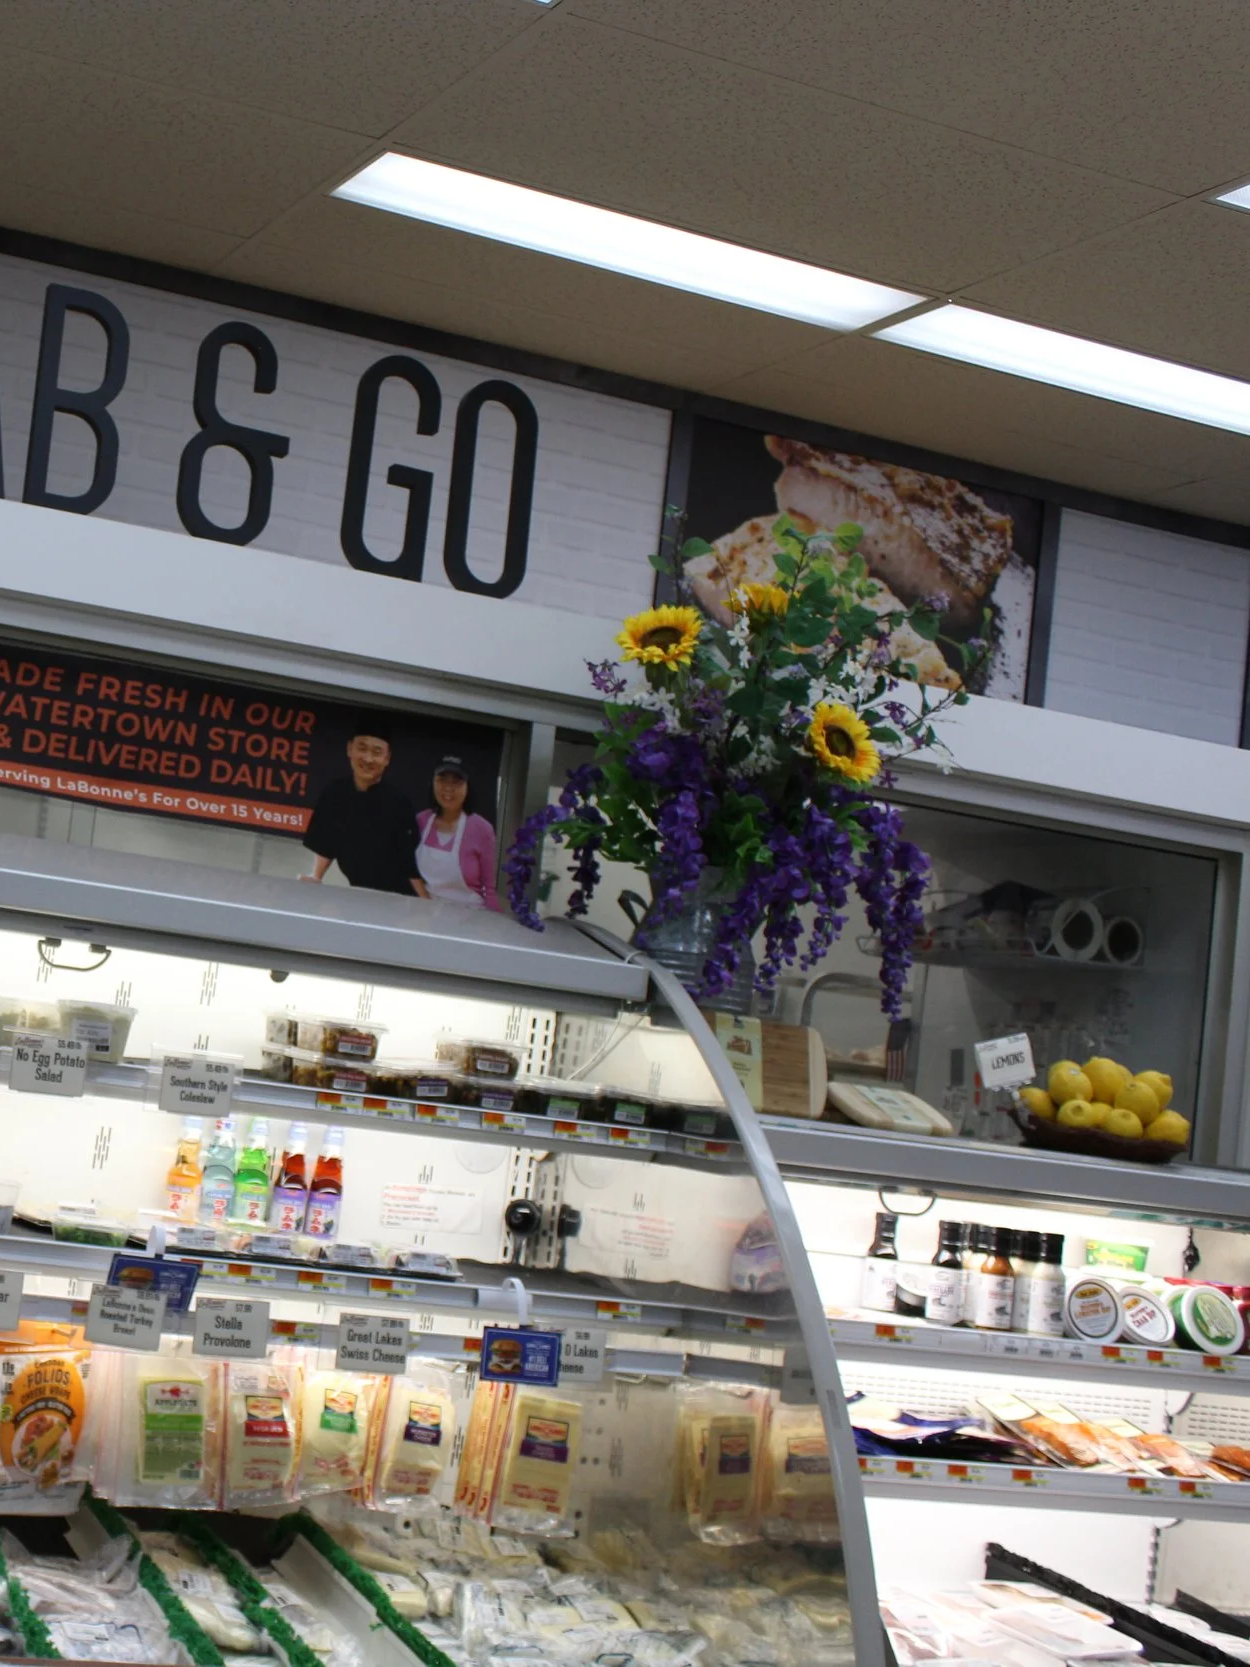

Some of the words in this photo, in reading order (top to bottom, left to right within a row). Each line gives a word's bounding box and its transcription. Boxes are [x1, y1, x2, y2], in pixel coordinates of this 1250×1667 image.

[176, 321, 290, 547] &
[340, 354, 539, 600] GO
[76, 672, 190, 713] FRESH
[199, 693, 235, 721] IN
[245, 702, 316, 735] OUR
[207, 727, 312, 766] STORE
[22, 728, 201, 780] DELIVERED
[210, 759, 309, 796] DAILY!
[57, 777, 148, 803] LaBonne's
[153, 792, 181, 809] For
[186, 797, 226, 815] Over
[231, 803, 248, 818] 15
[253, 807, 304, 827] Years!
[15, 1049, 29, 1062] No
[32, 1050, 50, 1067] Egg
[54, 1053, 86, 1069] Potato
[991, 1051, 1025, 1070] LEMONS
[35, 1068, 63, 1084] Salad
[170, 1076, 207, 1090] Southern
[208, 1079, 228, 1093] Style
[214, 1316, 243, 1331] Stella
[203, 1333, 252, 1349] Provolone
[346, 1329, 372, 1344] Great
[375, 1331, 403, 1347] Lakes
[340, 1345, 370, 1361] Swiss
[372, 1348, 406, 1364] Cheese
[574, 1345, 599, 1359] Lakes
[27, 1368, 70, 1388] FOLIOS
